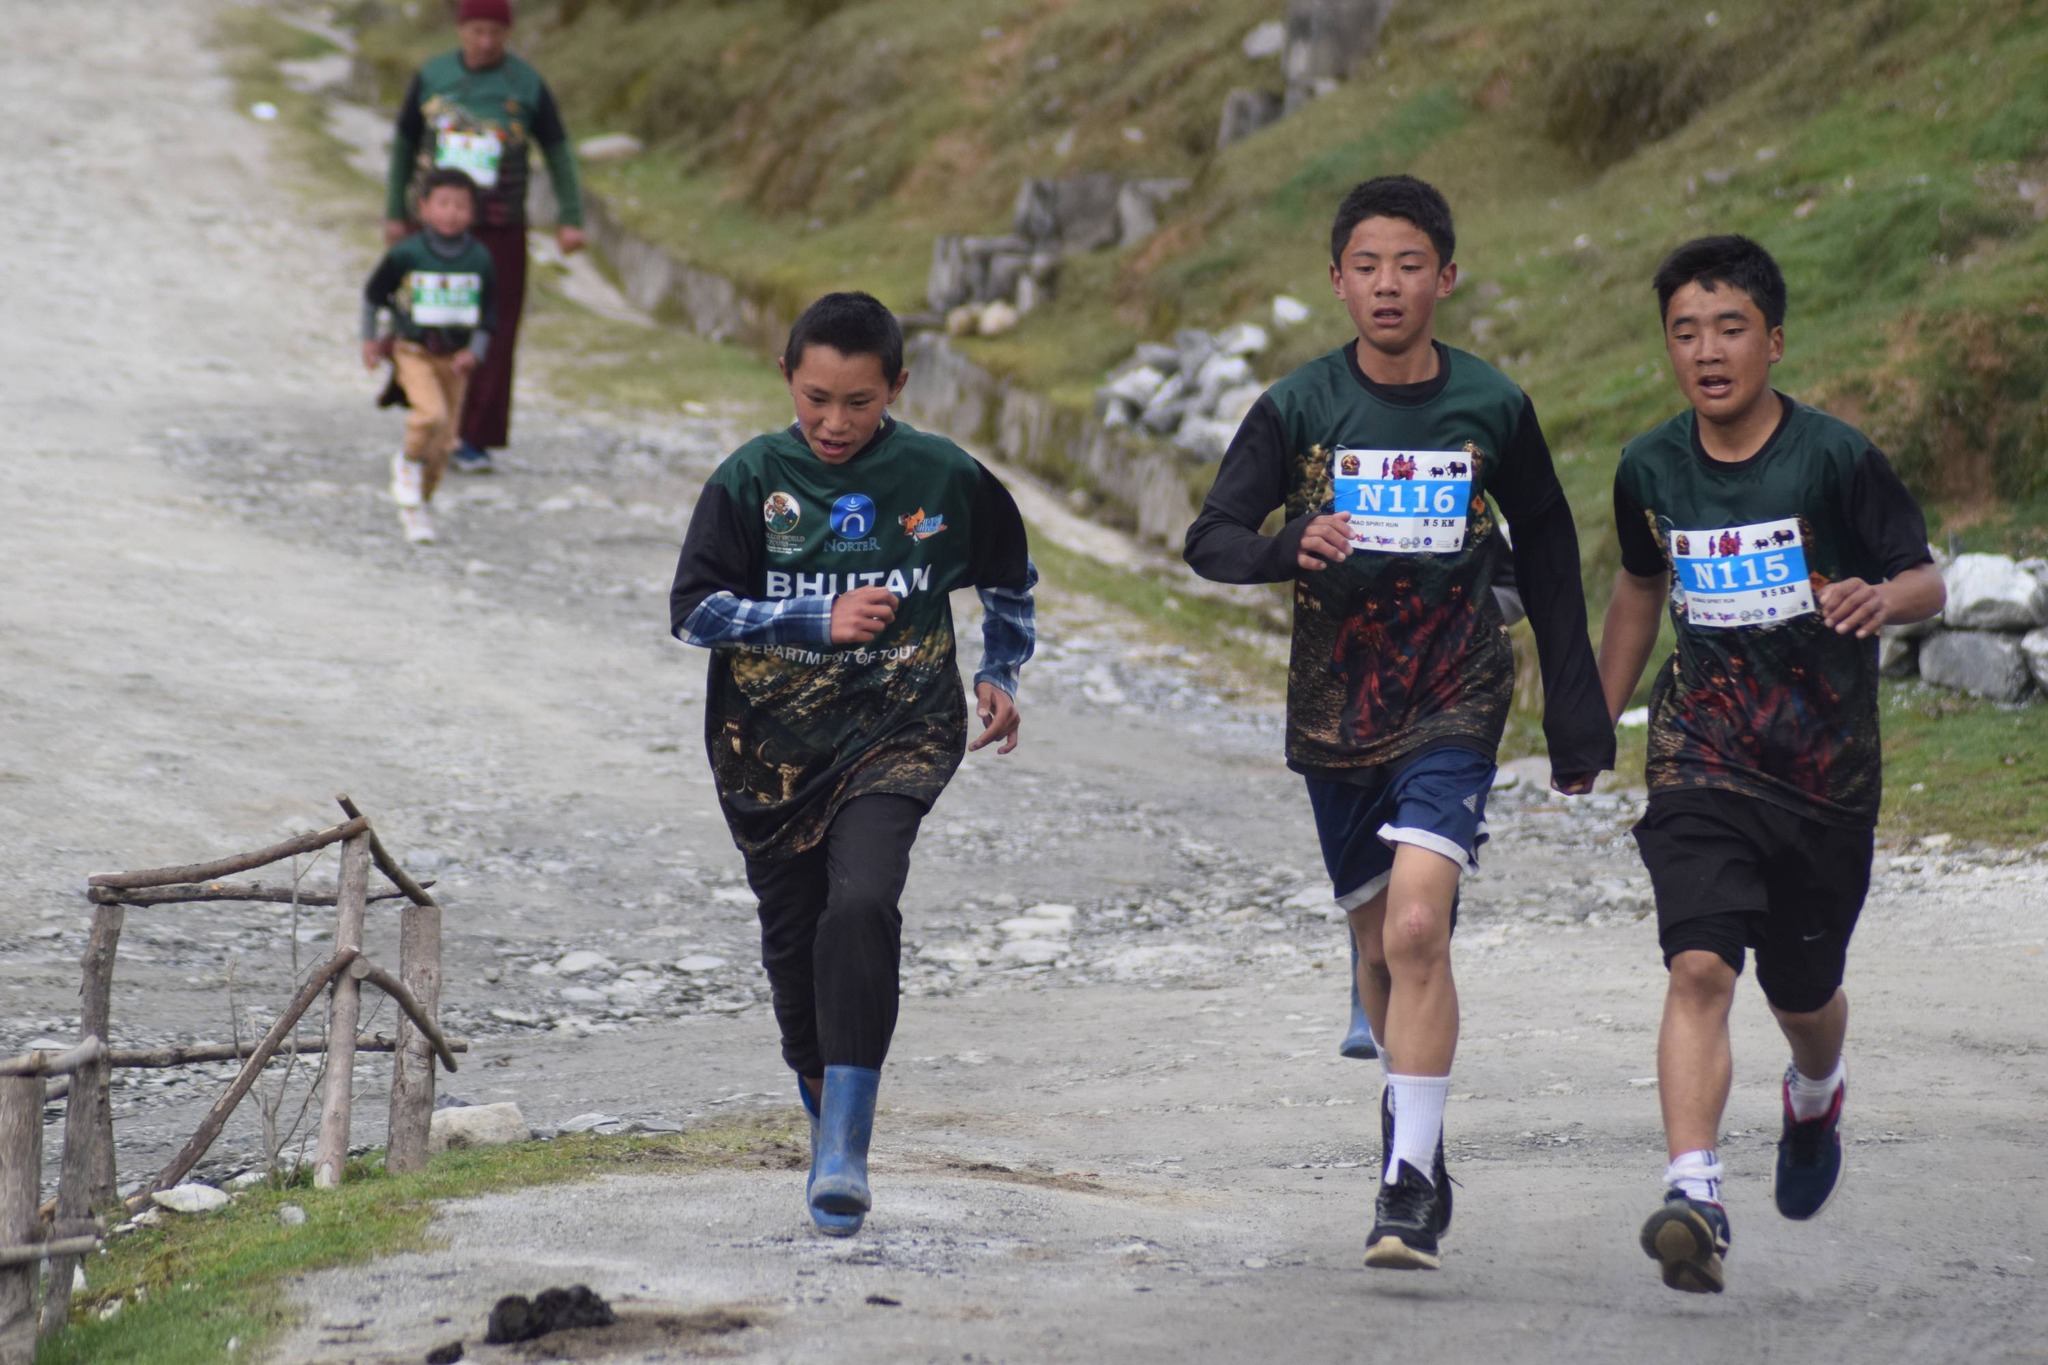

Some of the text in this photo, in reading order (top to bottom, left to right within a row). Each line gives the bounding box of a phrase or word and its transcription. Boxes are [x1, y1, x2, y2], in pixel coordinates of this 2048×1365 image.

[1356, 483, 1455, 513] N116
[1423, 519, 1455, 527] N 5 KM
[823, 537, 881, 553] NORTER
[1691, 553, 1789, 590] N115
[766, 563, 932, 598] BHUTAN
[1760, 585, 1795, 598] N 5 KM
[856, 651, 876, 664] OF
